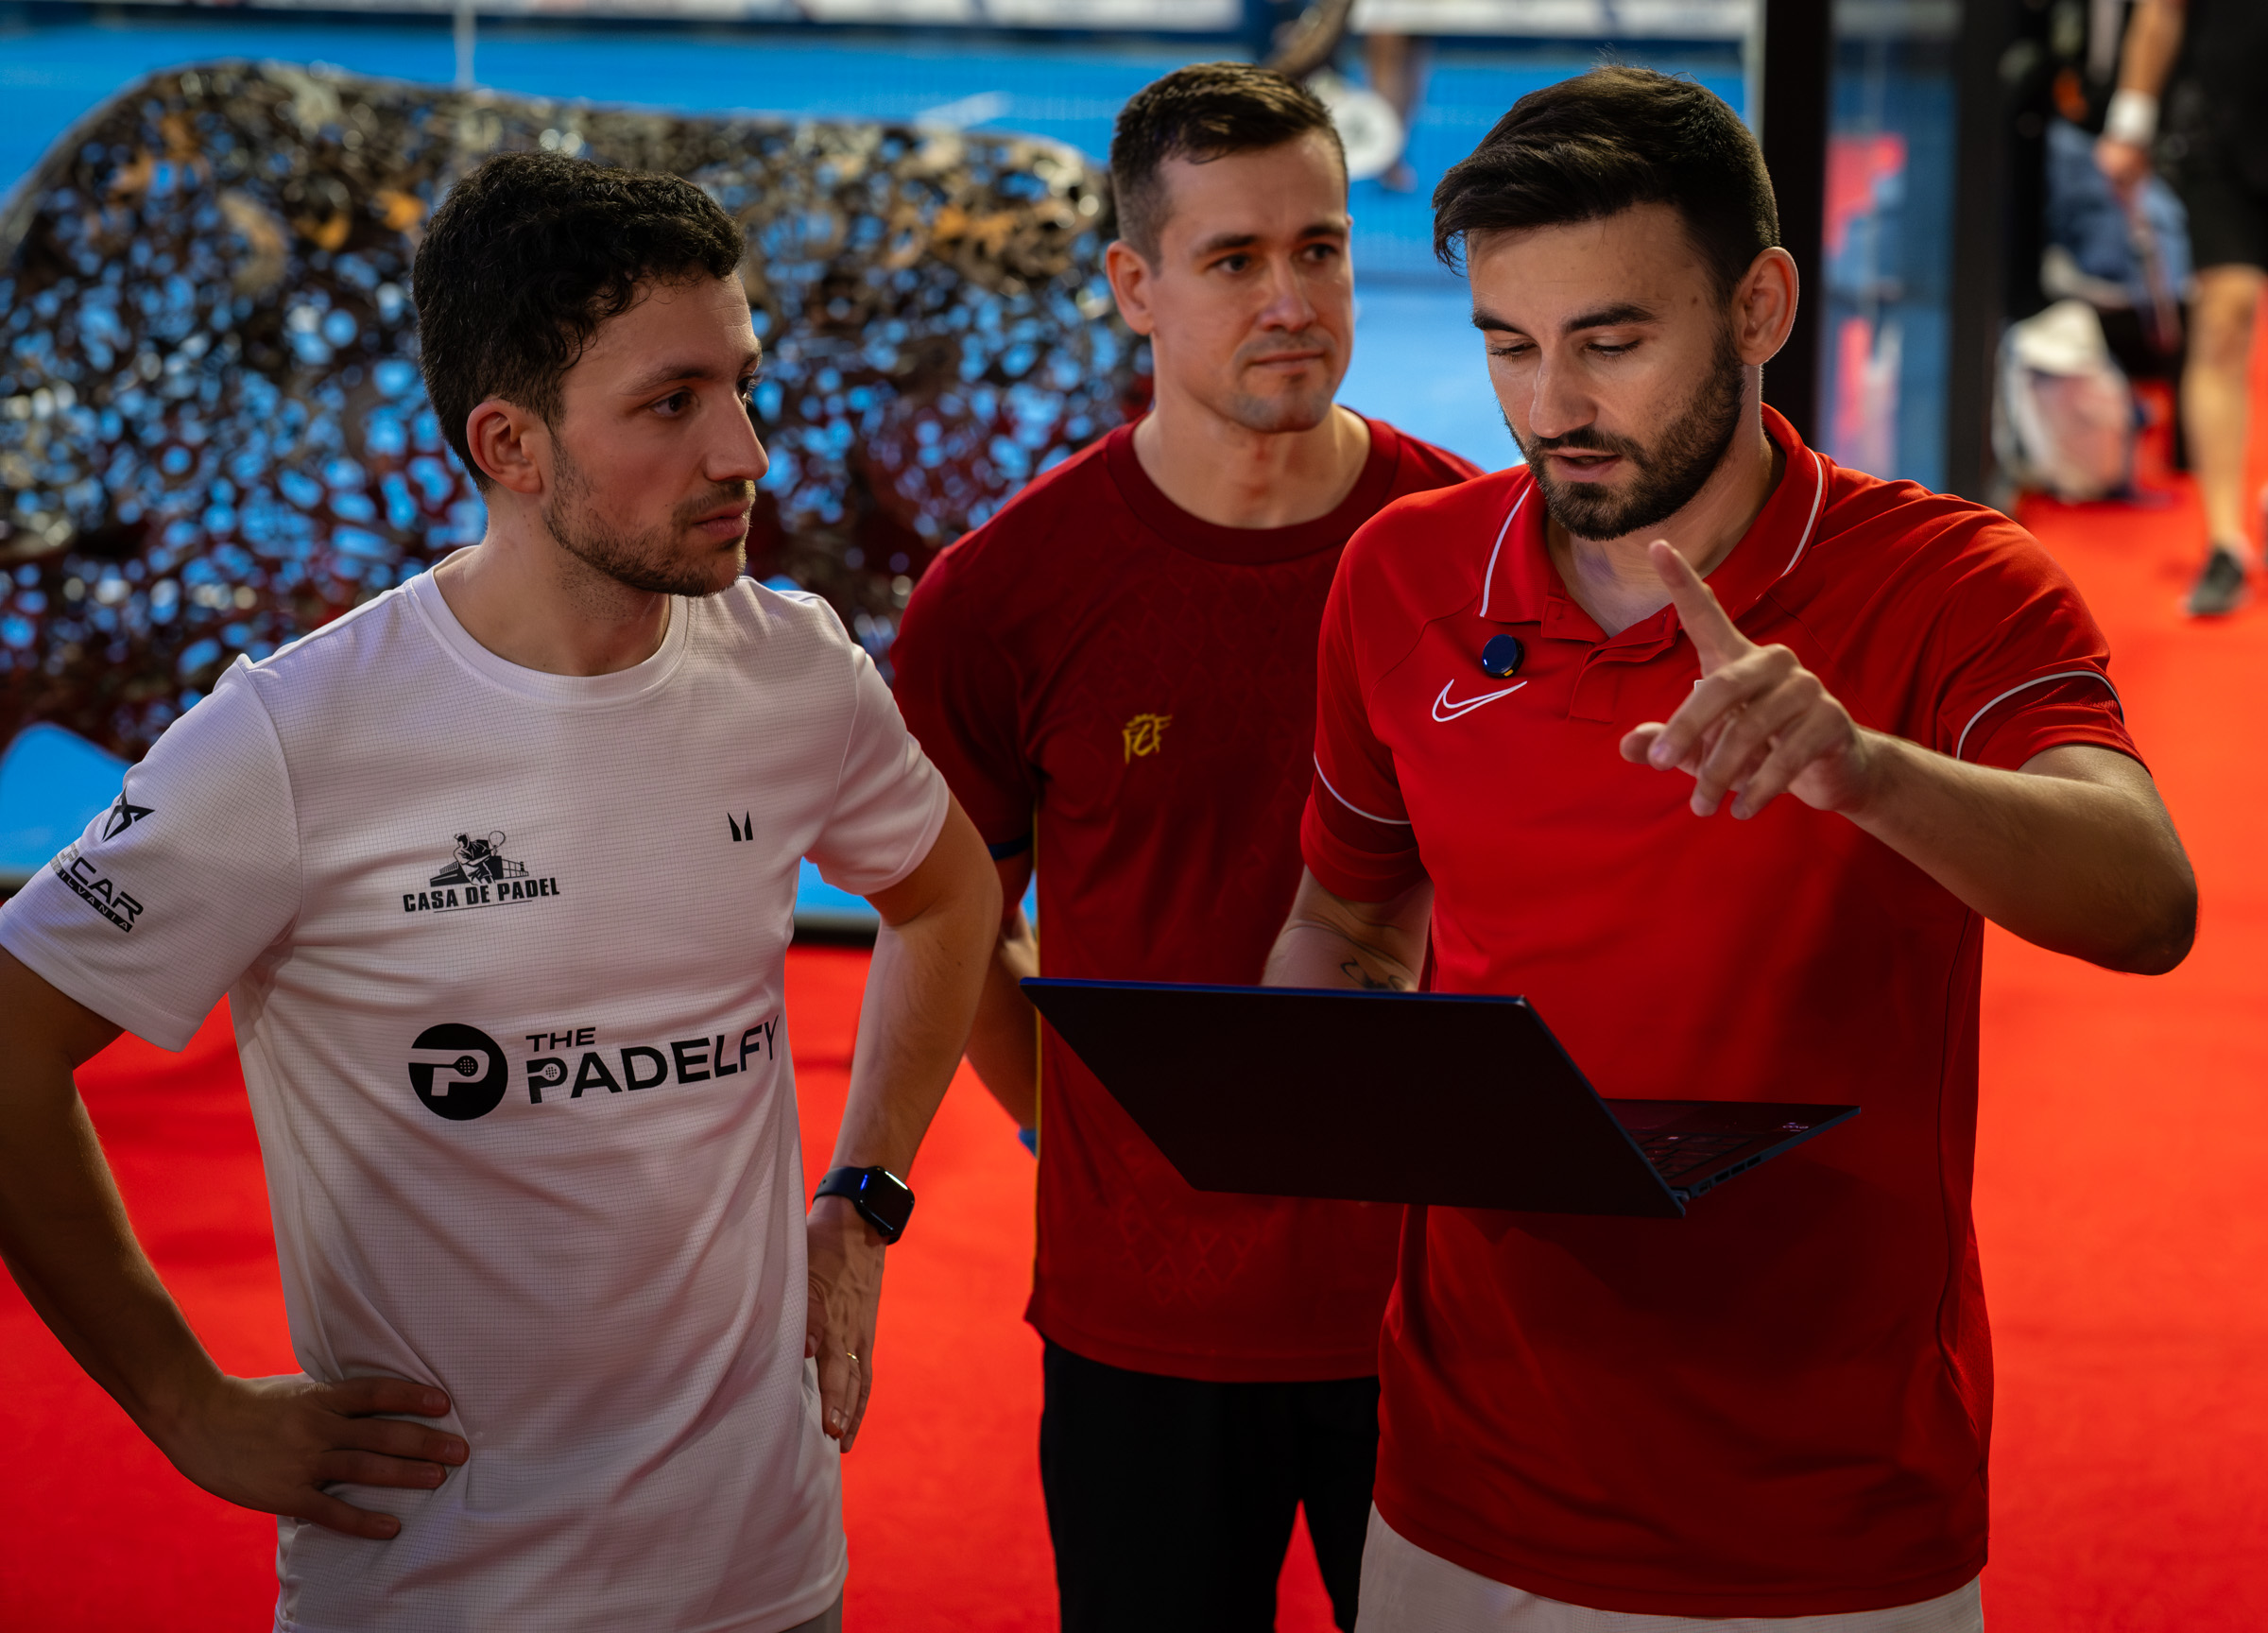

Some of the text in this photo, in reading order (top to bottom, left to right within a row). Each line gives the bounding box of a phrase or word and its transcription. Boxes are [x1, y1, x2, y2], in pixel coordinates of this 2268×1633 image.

[403, 877, 560, 912] CASA DE PADEL
[525, 1027, 596, 1053] THE
[525, 1014, 779, 1105] PADELFY
